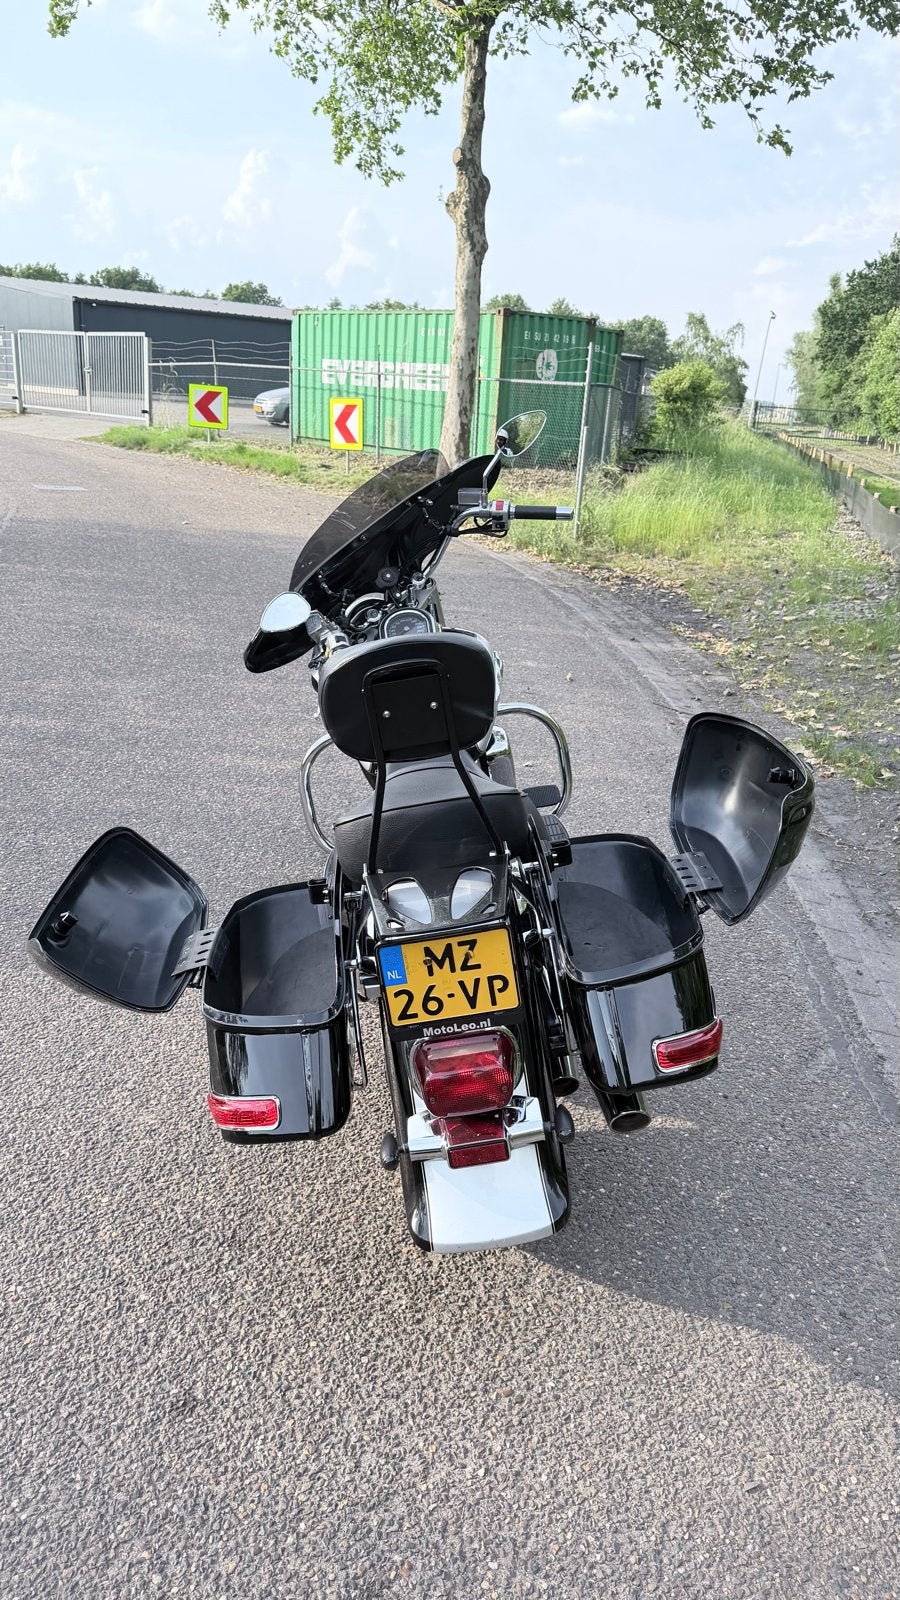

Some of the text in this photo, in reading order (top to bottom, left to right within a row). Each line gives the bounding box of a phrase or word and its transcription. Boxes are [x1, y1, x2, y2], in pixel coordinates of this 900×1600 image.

[423, 938, 482, 977] MZ
[387, 970, 402, 981] NL
[393, 974, 510, 1021] 26-VP
[422, 1018, 492, 1037] MotoLeo.nl
